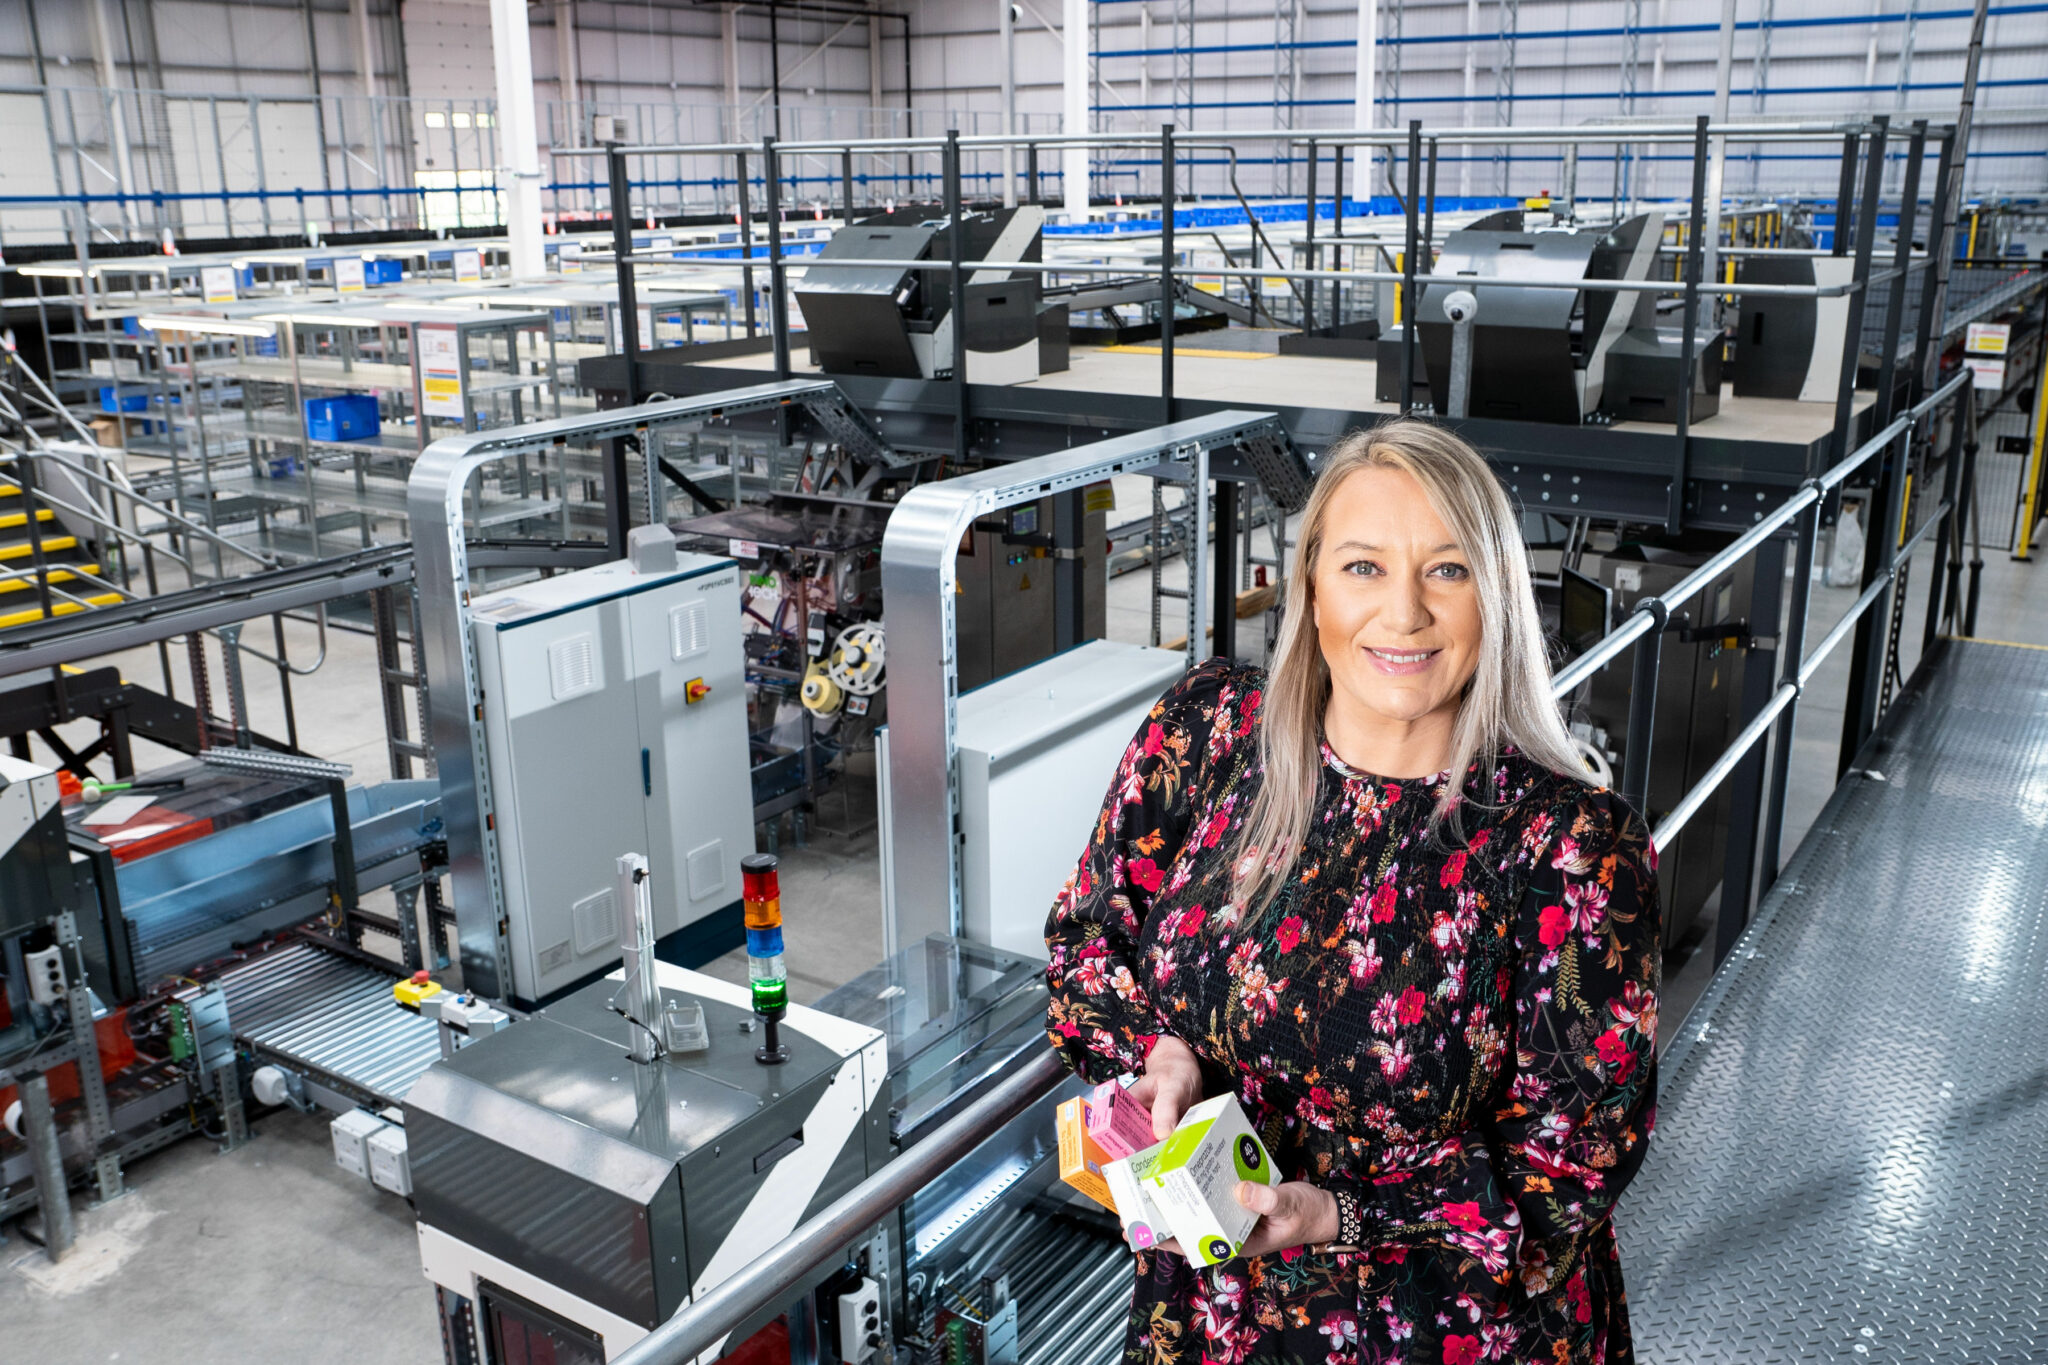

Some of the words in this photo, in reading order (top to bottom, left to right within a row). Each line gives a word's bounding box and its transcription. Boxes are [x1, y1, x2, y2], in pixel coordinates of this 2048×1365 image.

[1117, 1088, 1152, 1127] Lisinopril
[1190, 1141, 1214, 1177] Omeprazole
[1244, 1142, 1253, 1156] 40
[1249, 1153, 1258, 1164] mg
